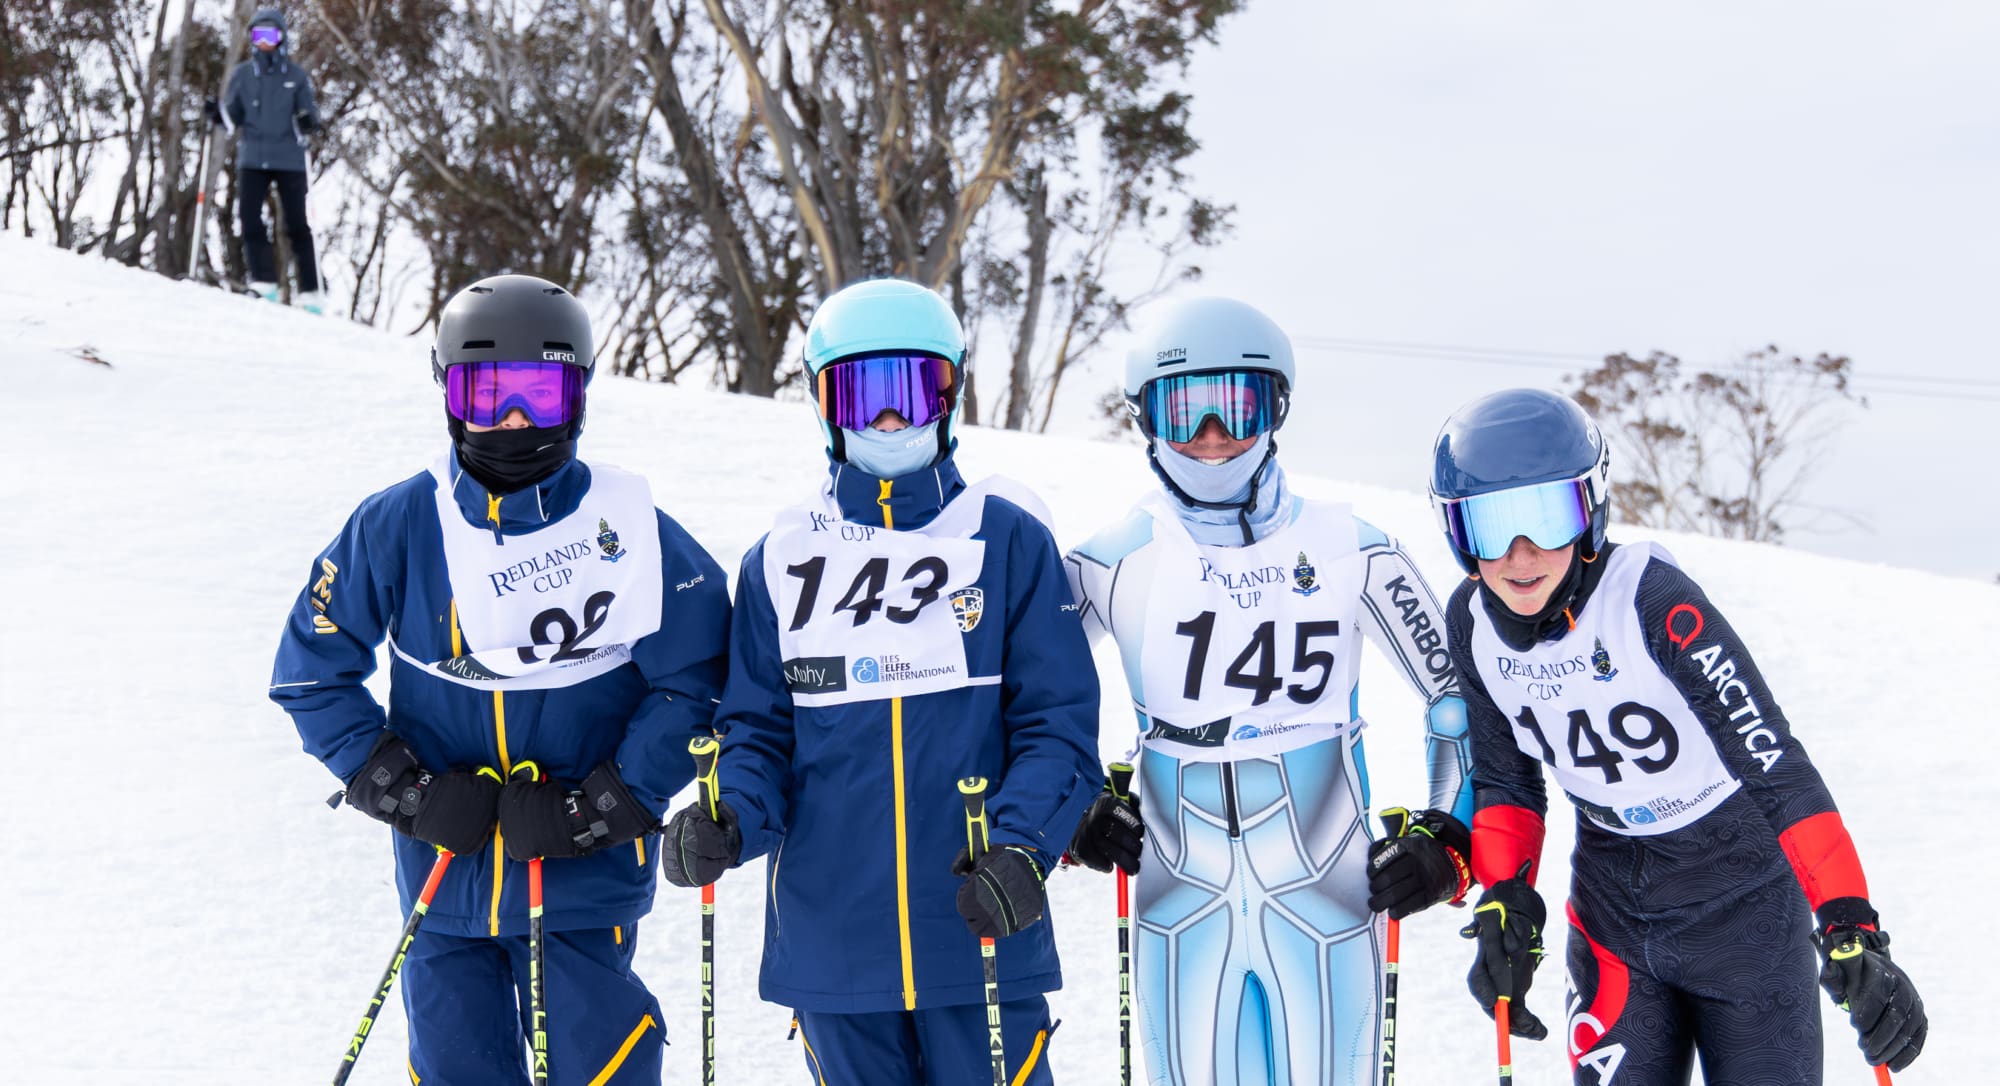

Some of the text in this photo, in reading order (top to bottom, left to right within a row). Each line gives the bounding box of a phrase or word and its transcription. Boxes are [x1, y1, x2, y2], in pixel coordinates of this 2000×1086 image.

[543, 351, 576, 363] GIRO
[1157, 348, 1187, 361] SMITH
[841, 526, 875, 541] CUP
[488, 539, 592, 598] REDLANDS
[533, 568, 573, 593] CUP
[786, 556, 949, 632] 143
[1230, 590, 1262, 609] UP
[1385, 574, 1459, 693] KARBON
[884, 655, 900, 664] LES
[885, 663, 911, 673] ELFES
[885, 665, 958, 682] INTERNATIONAL
[1175, 611, 1340, 706] 145
[1496, 656, 1586, 681] REDLANDS
[1691, 645, 1784, 773] ARCTICA
[1514, 701, 1679, 784] 149
[1657, 798, 1684, 813] ELFES
[1119, 952, 1131, 1021] LEKI
[343, 998, 382, 1063] LEKI
[984, 982, 1004, 1056] LEKI
[533, 1011, 548, 1079] LEKI
